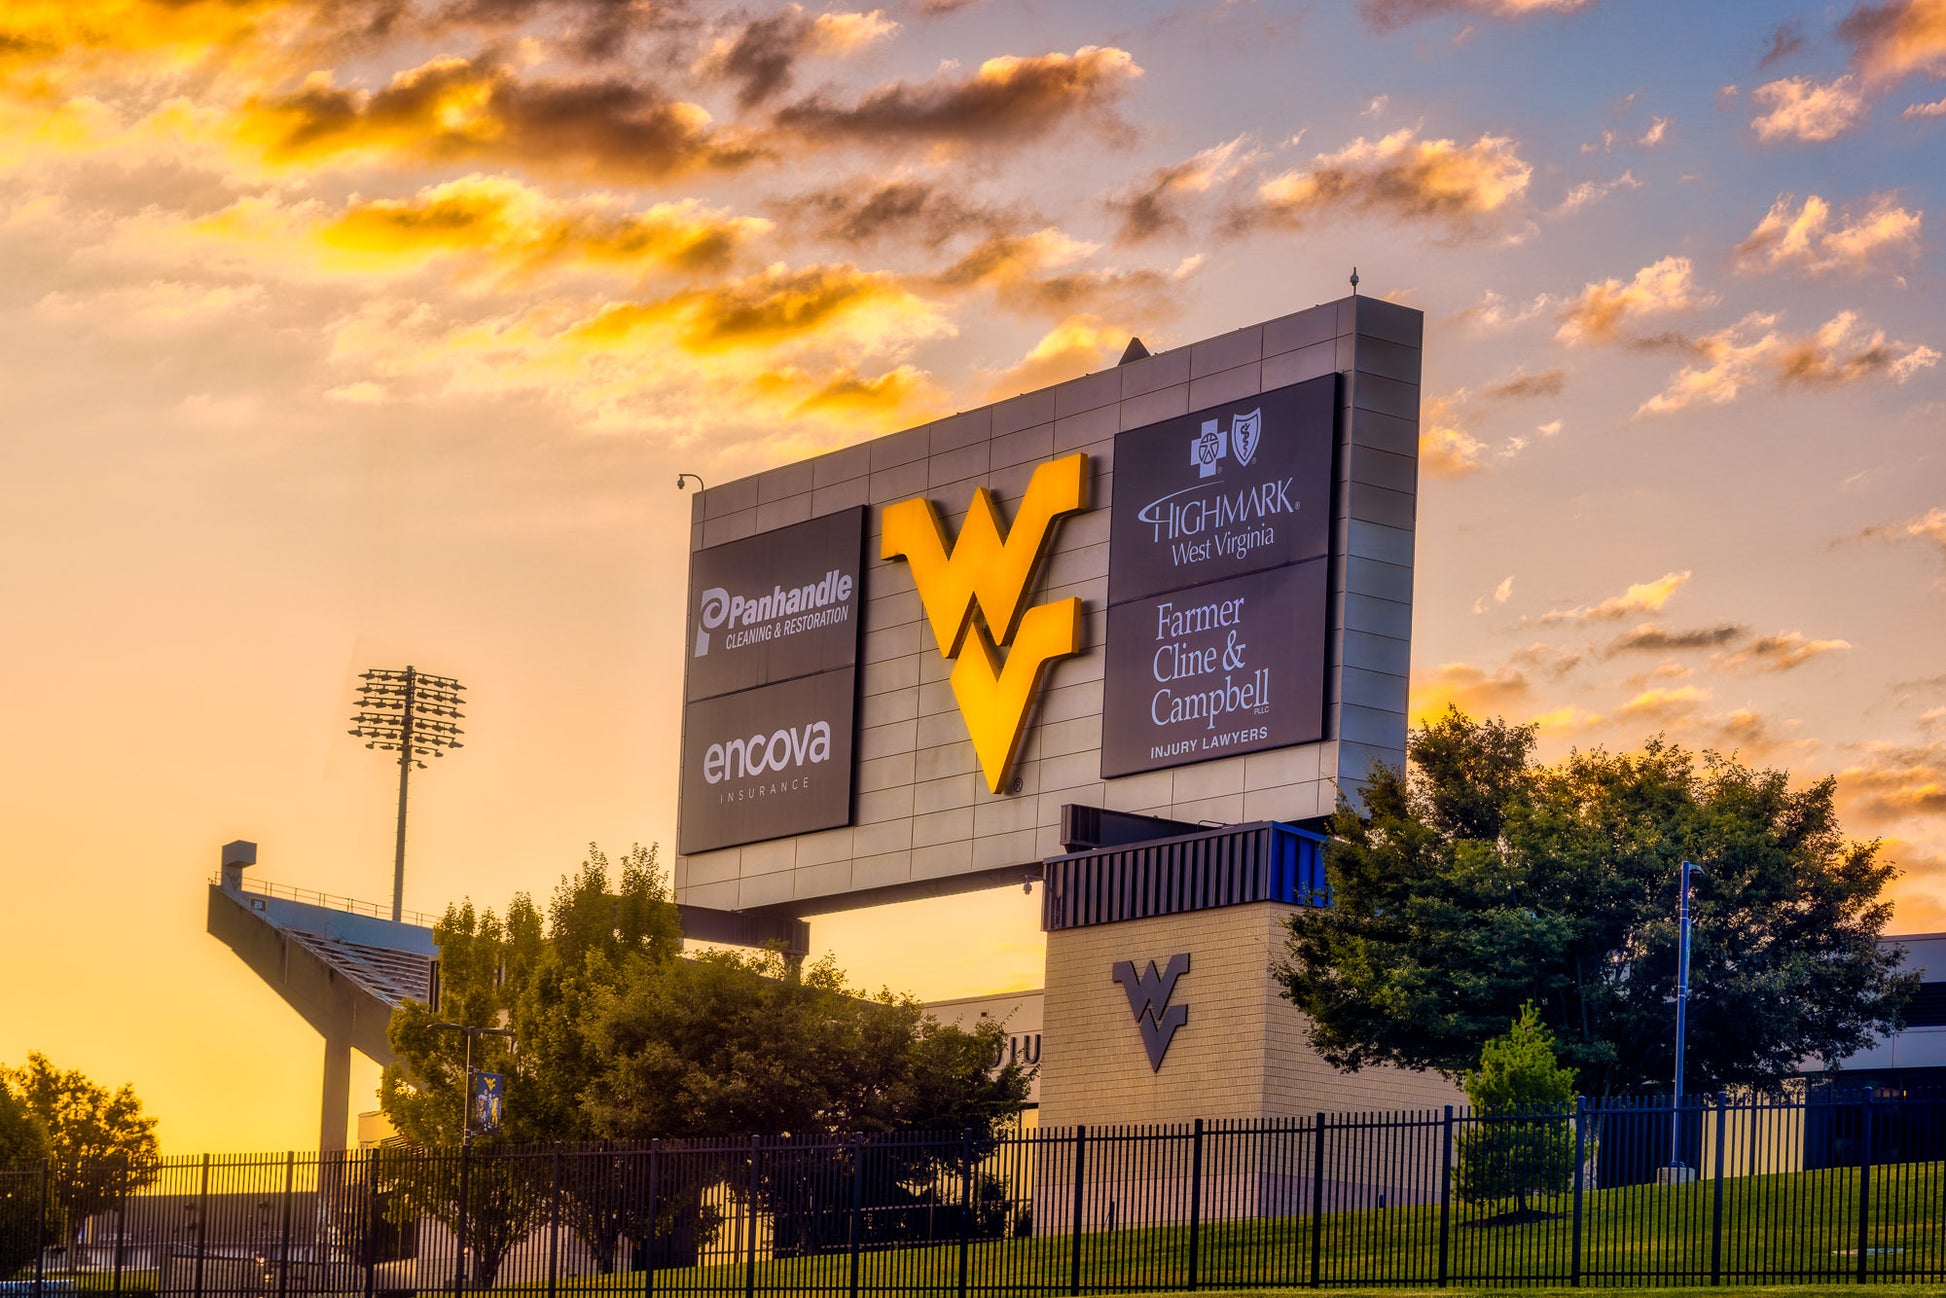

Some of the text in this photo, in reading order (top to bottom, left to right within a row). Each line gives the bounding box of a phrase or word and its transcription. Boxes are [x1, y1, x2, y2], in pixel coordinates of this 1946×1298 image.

[1148, 477, 1295, 544] HIGHMARK
[1171, 523, 1275, 567] West Virginia
[728, 569, 853, 630] Panhandle
[1156, 597, 1245, 641] Farmer
[726, 605, 849, 650] CLEANING & RESTORATION
[1153, 629, 1247, 683] Cline &
[1151, 667, 1270, 730] Campbell
[1254, 705, 1270, 716] PLLC
[703, 720, 831, 785] encova
[1151, 726, 1268, 760] INJURY LAWYERS
[720, 776, 809, 805] INSURANCE
